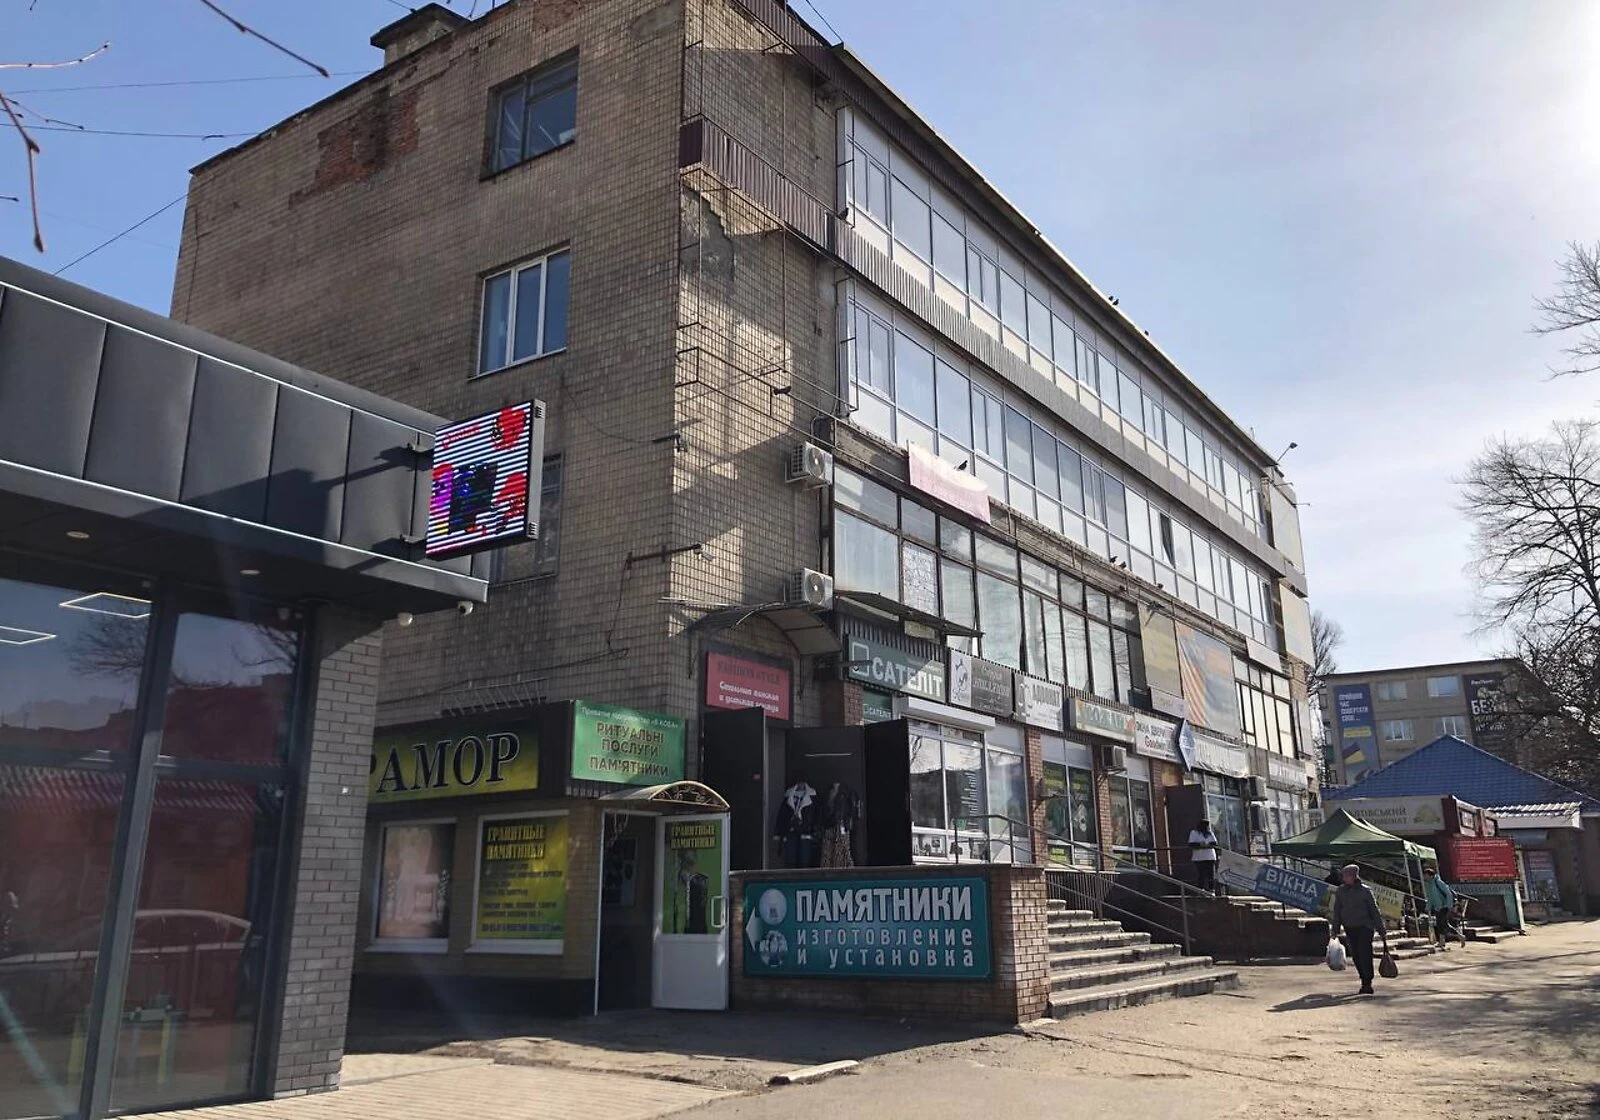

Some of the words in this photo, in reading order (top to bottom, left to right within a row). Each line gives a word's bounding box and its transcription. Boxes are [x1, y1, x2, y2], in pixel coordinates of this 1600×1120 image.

[872, 656, 943, 698] САТЕЛІТ
[596, 722, 665, 744] РИТУАЛЬНІ
[602, 738, 659, 758] ПОСЛУГИ
[589, 756, 669, 777] ПАМ'ЯТНИКИ
[487, 824, 546, 842] ГРАНИТНЫЕ
[1265, 869, 1319, 898] ВІКНА
[795, 886, 972, 923] ПАМЯТНИКИ
[797, 928, 973, 946] изготовление
[797, 949, 807, 966] и
[828, 948, 974, 969] установка
